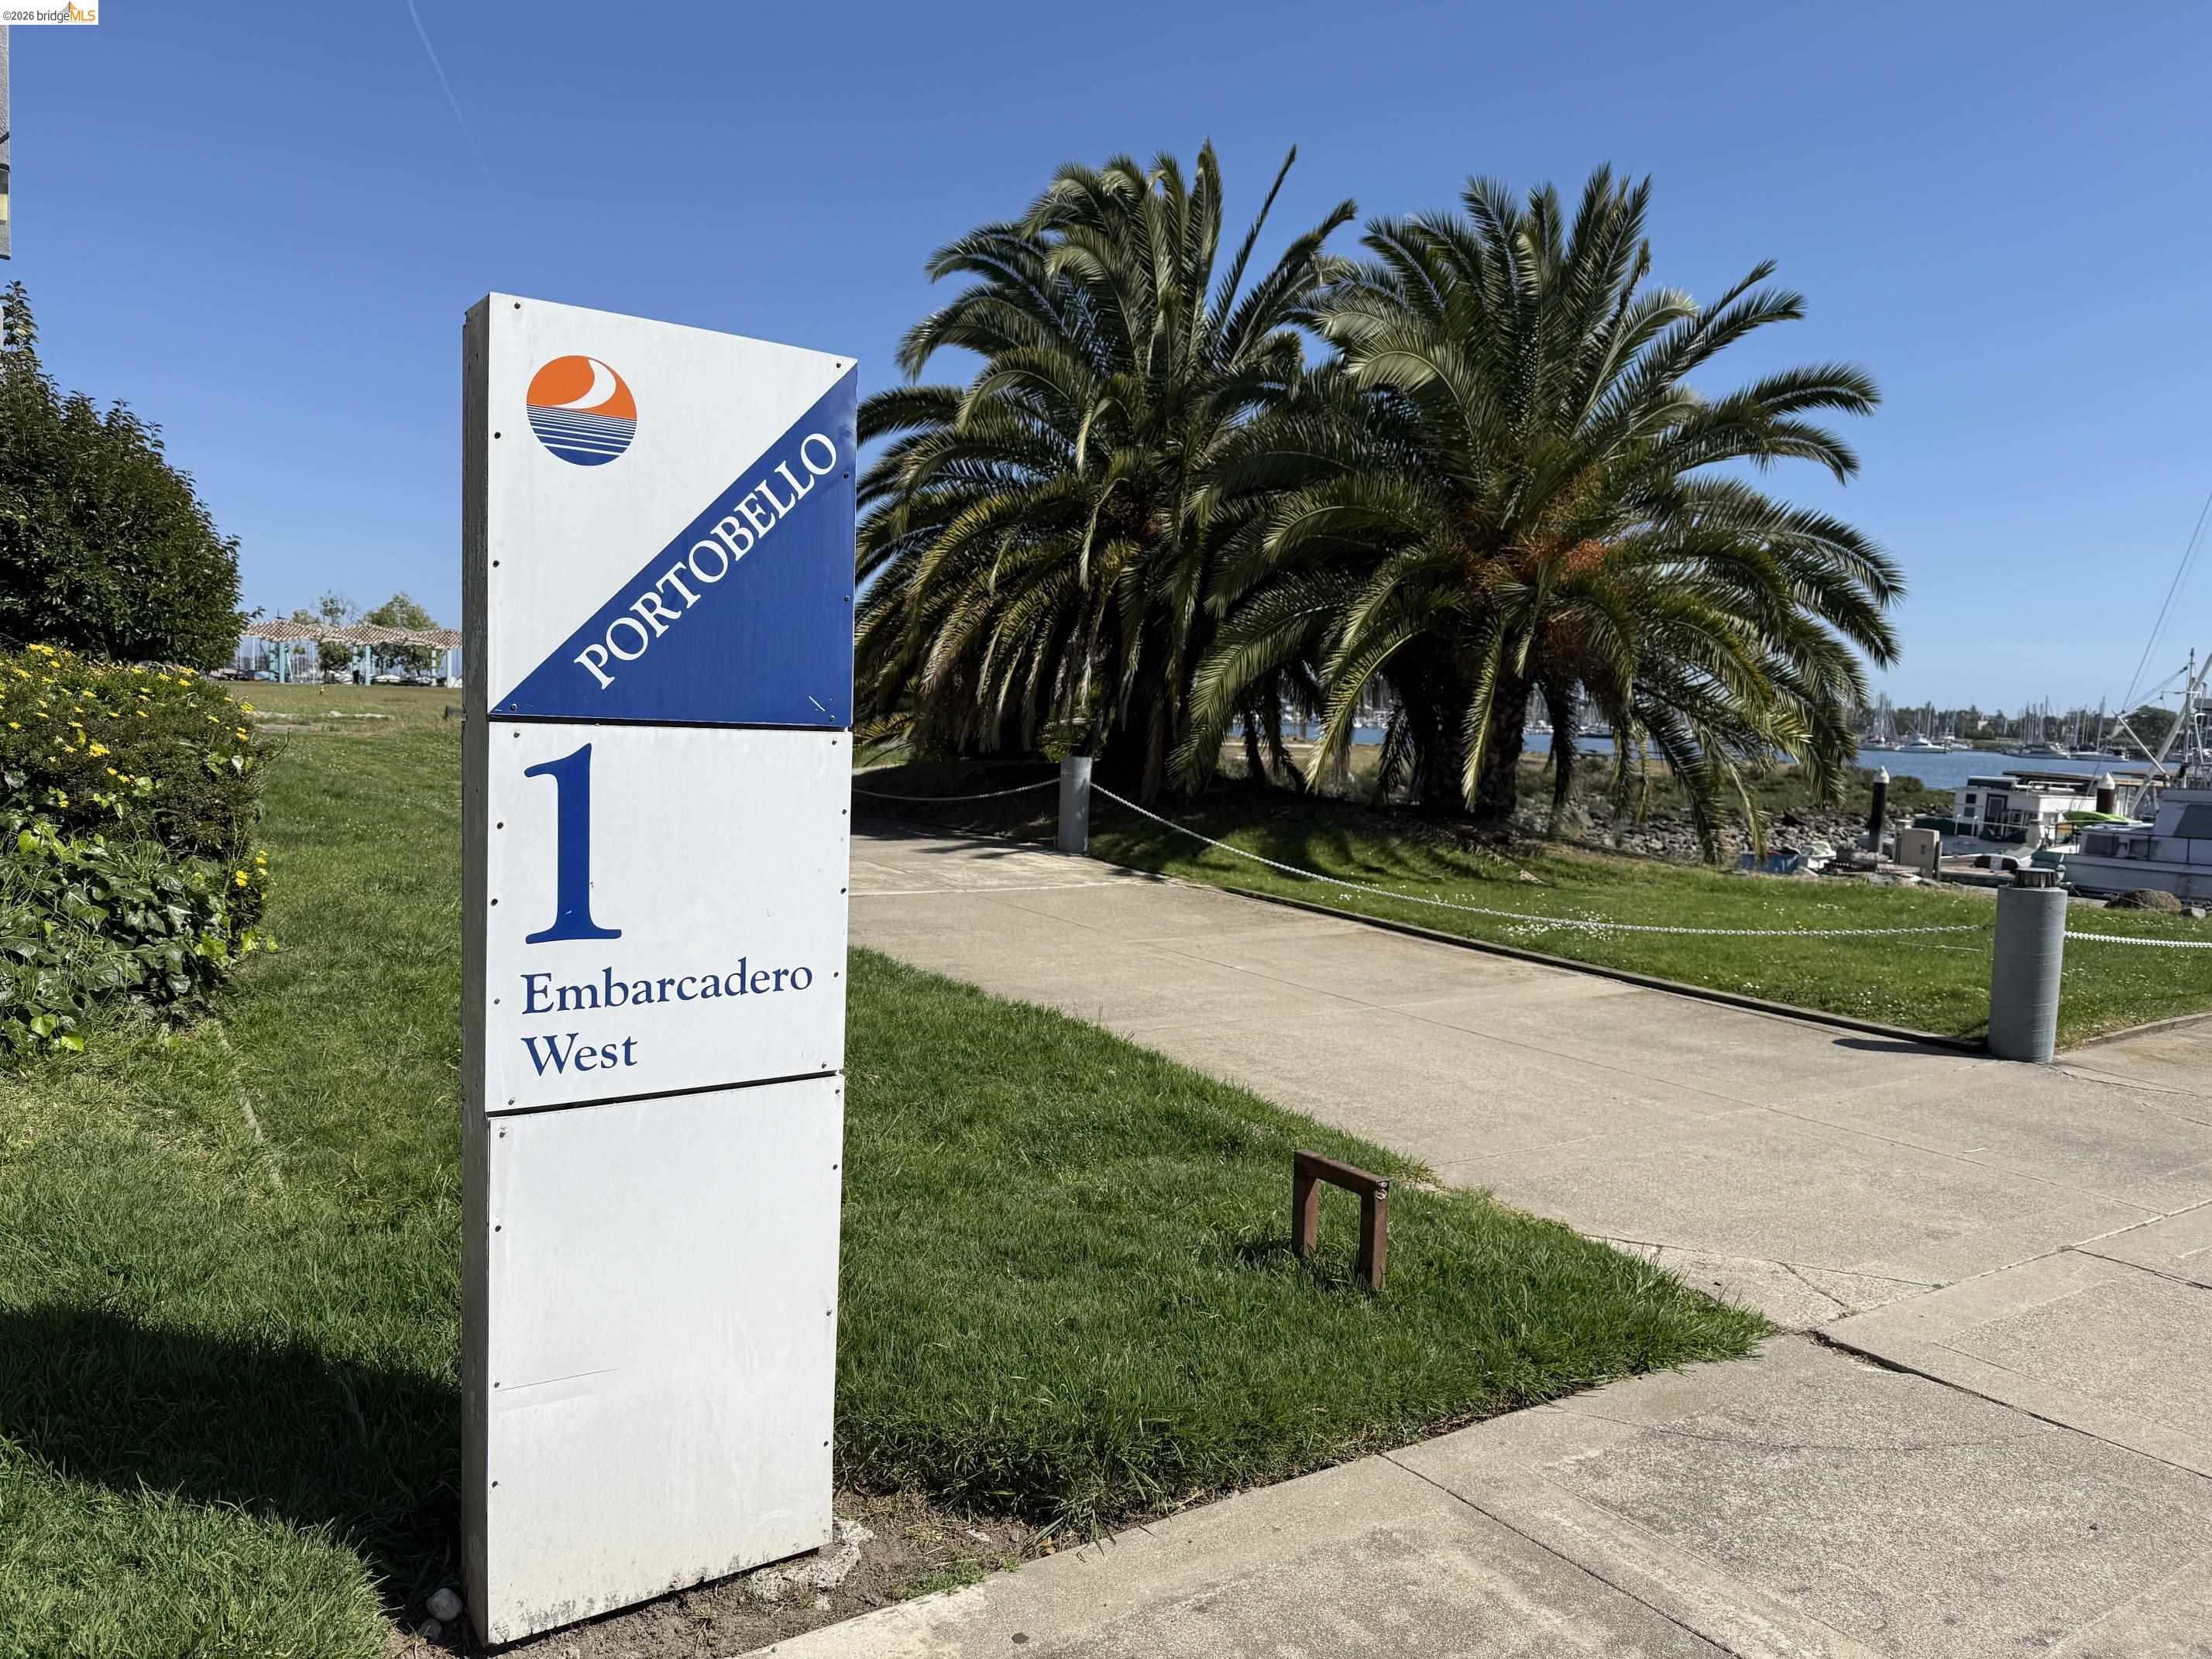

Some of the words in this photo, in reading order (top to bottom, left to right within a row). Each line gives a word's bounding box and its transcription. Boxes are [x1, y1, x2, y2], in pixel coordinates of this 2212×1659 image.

[573, 432, 837, 690] PORTOBELLO
[524, 743, 622, 944] 1
[520, 957, 813, 1015] Embarcadero
[520, 1032, 638, 1077] West
